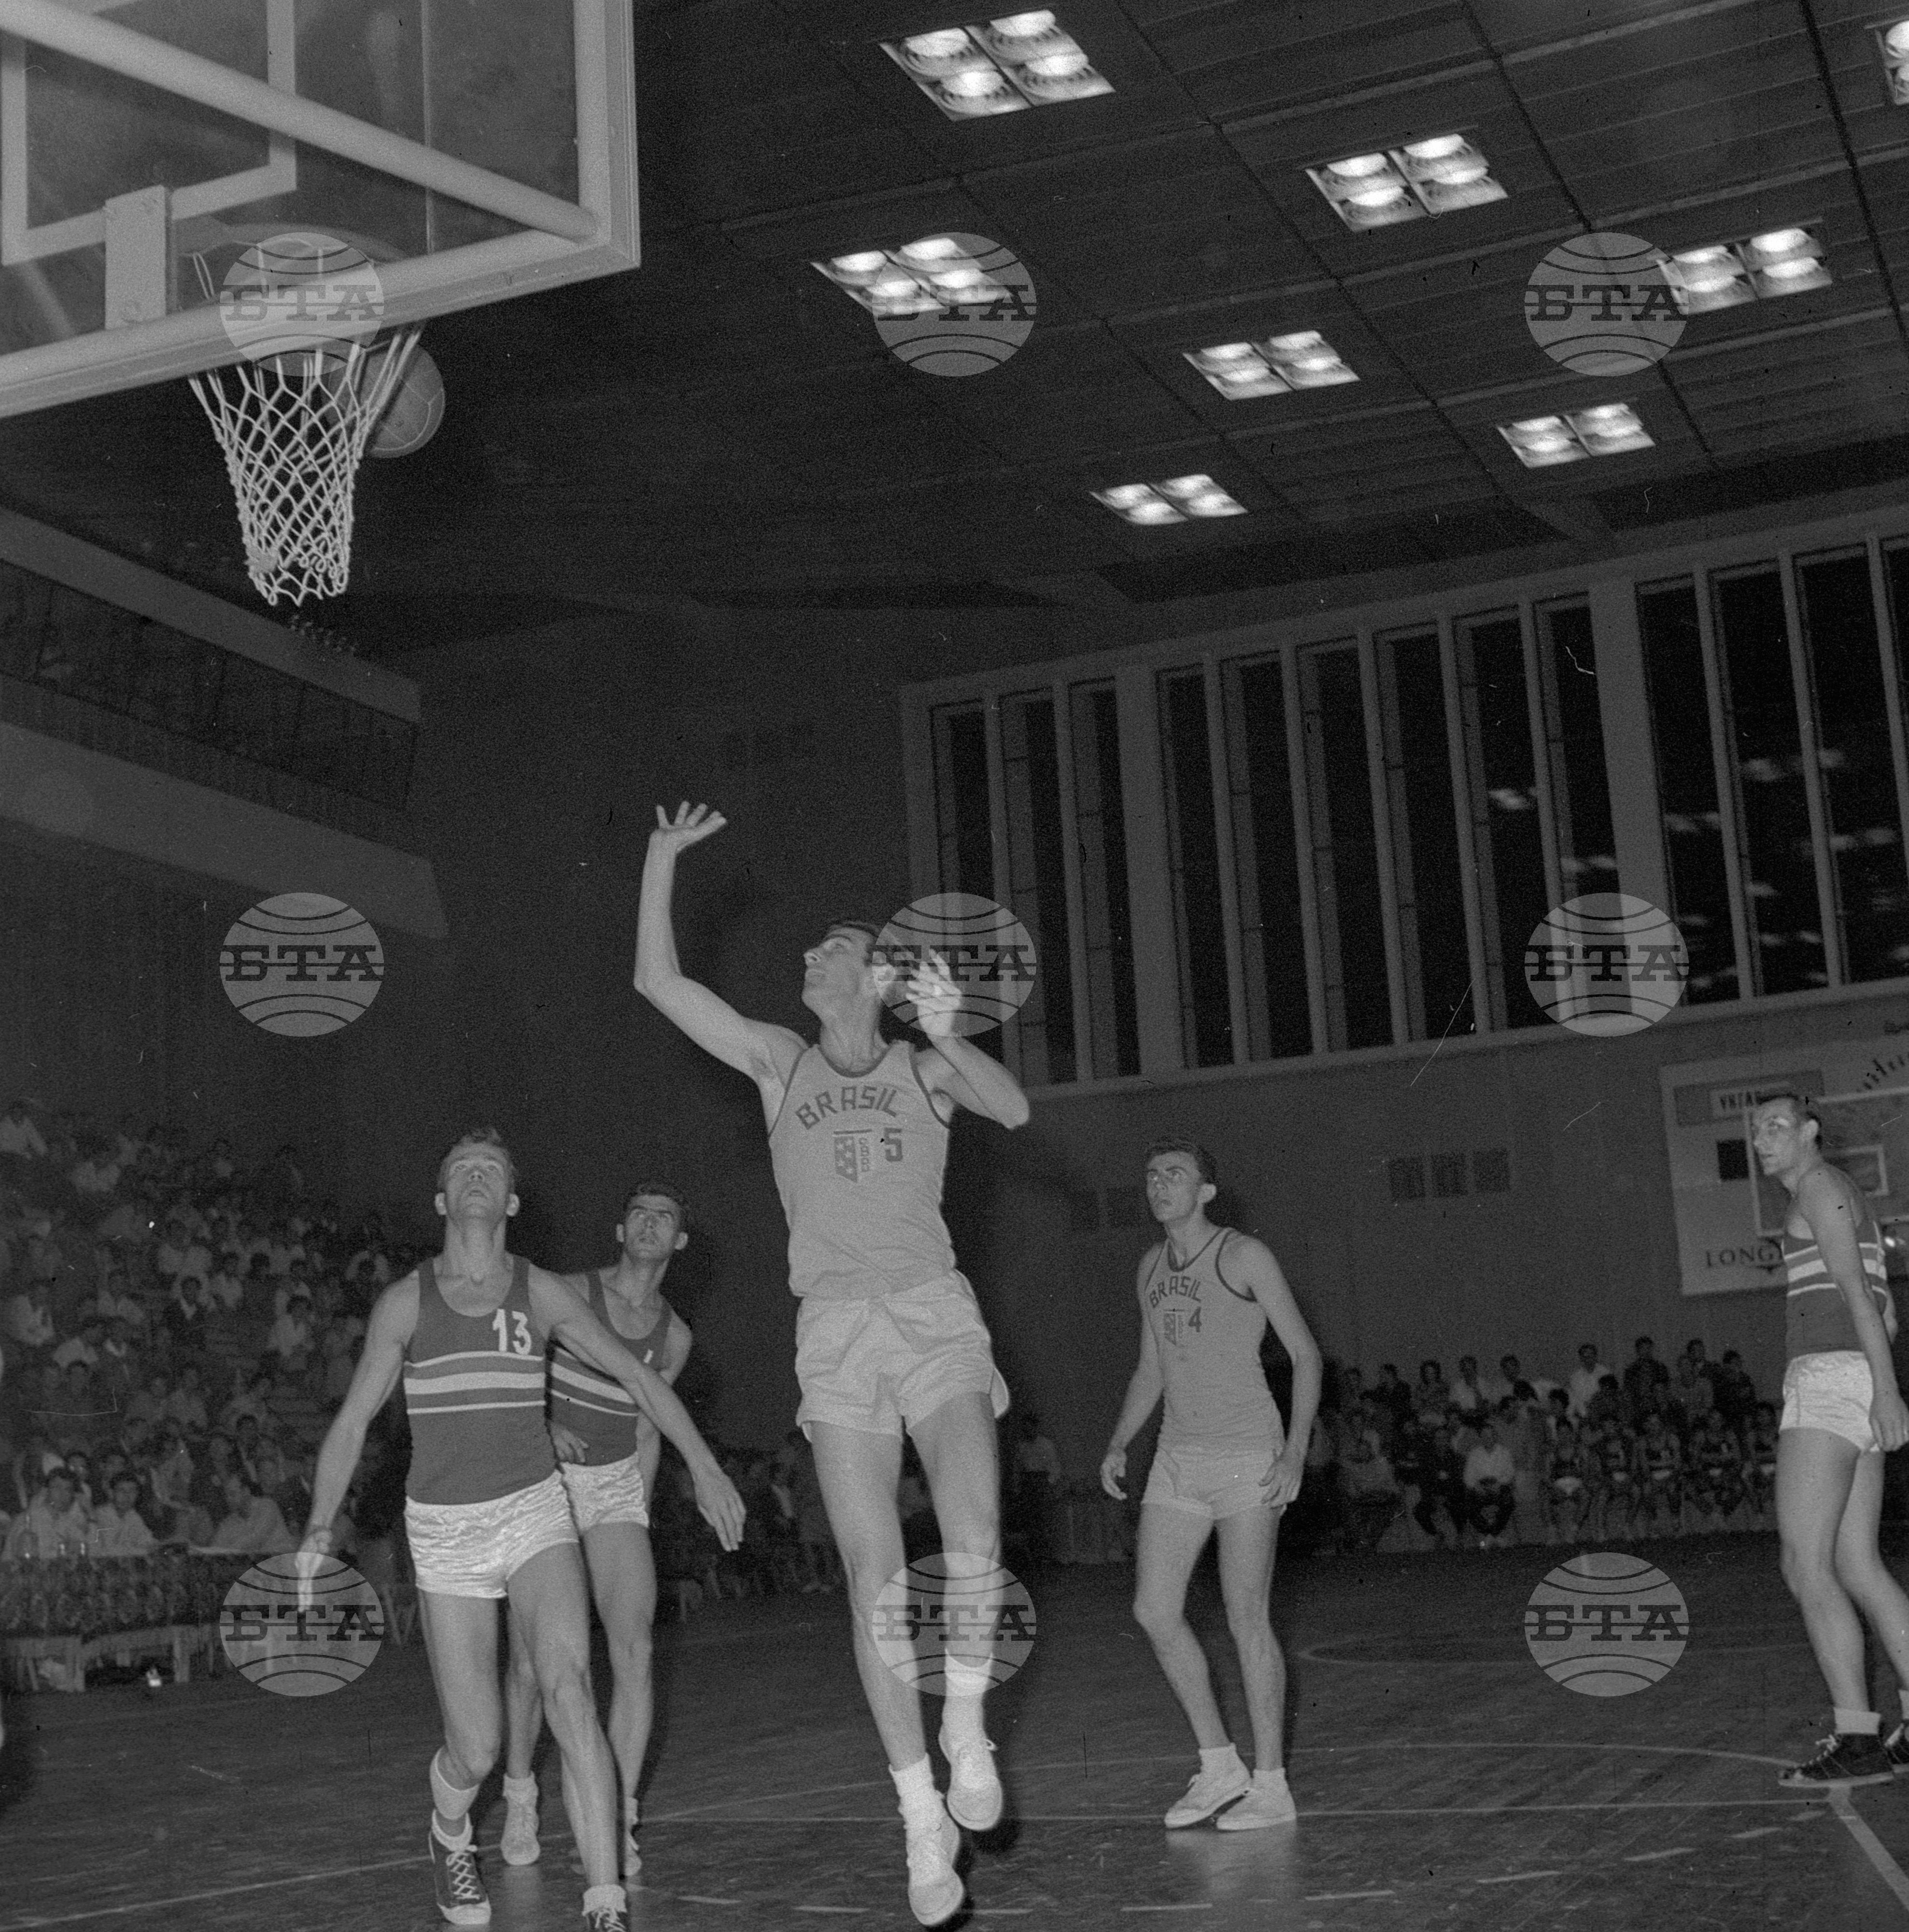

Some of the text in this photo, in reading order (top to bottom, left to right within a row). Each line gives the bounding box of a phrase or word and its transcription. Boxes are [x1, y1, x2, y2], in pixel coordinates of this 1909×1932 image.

[795, 1085, 897, 1130] BRASIL
[884, 1128, 903, 1162] 5
[1149, 1276, 1201, 1308] BRASIL
[493, 1308, 531, 1354] 13
[1188, 1307, 1202, 1333] 4
